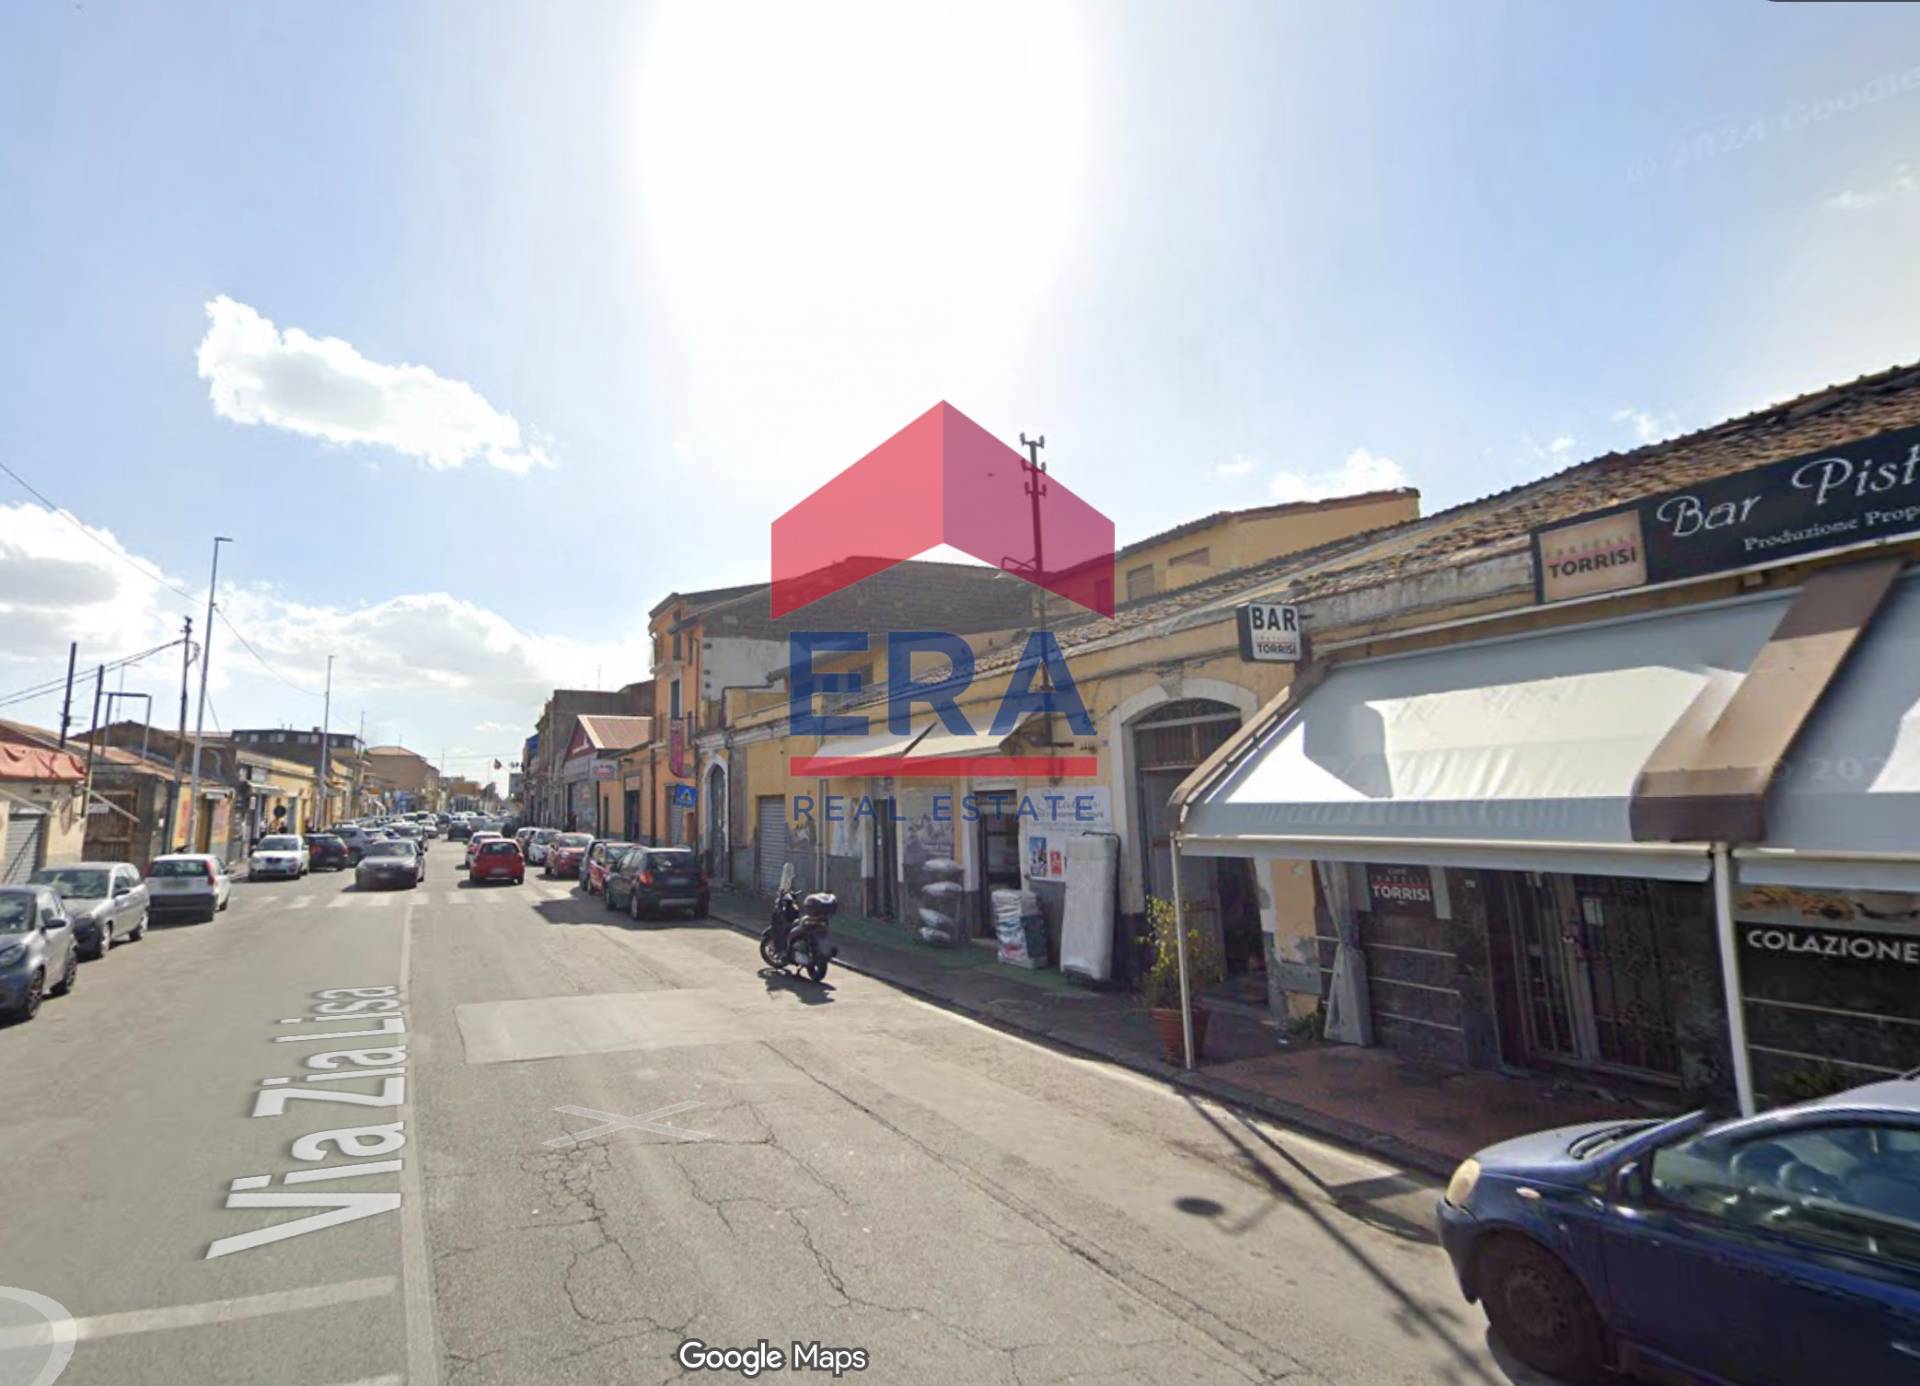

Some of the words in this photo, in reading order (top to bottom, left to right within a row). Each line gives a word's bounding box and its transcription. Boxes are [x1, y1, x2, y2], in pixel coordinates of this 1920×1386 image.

[1656, 495, 1762, 537] Bar
[1744, 517, 1858, 552] Produzione
[1549, 546, 1637, 579] TORRISI
[1252, 607, 1297, 632] BAR
[1372, 886, 1431, 902] TORRISI
[1747, 930, 1920, 963] COLAZIONE
